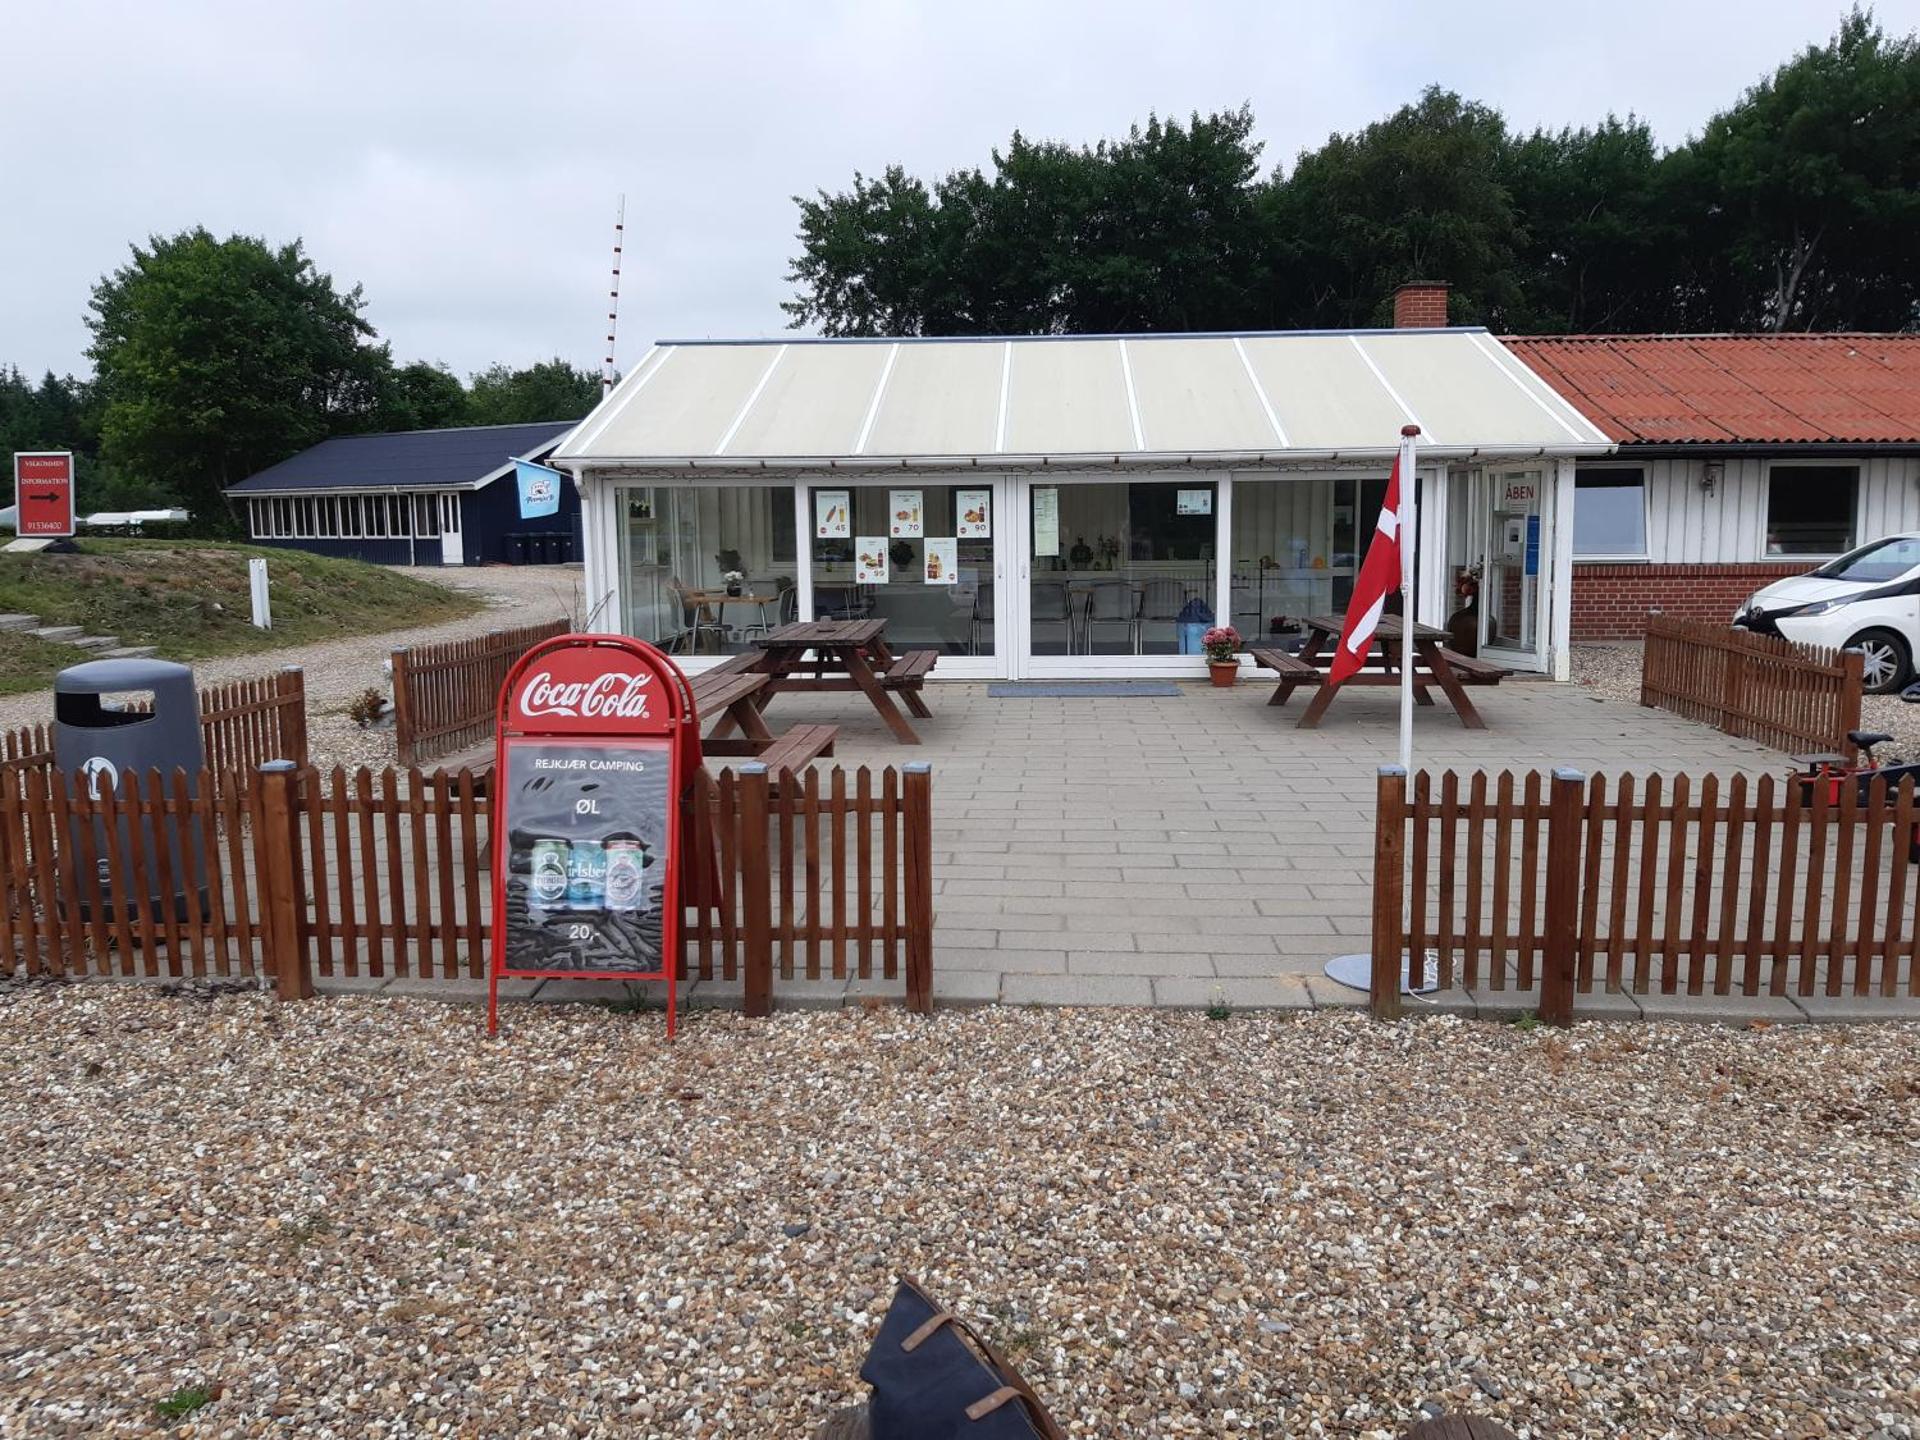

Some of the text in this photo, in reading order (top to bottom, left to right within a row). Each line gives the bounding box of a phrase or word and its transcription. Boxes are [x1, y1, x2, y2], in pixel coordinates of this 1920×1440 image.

[1505, 483, 1534, 500] ÅBEN
[535, 758, 644, 771] REJKJÆR CAMPING
[576, 799, 601, 814] ØL
